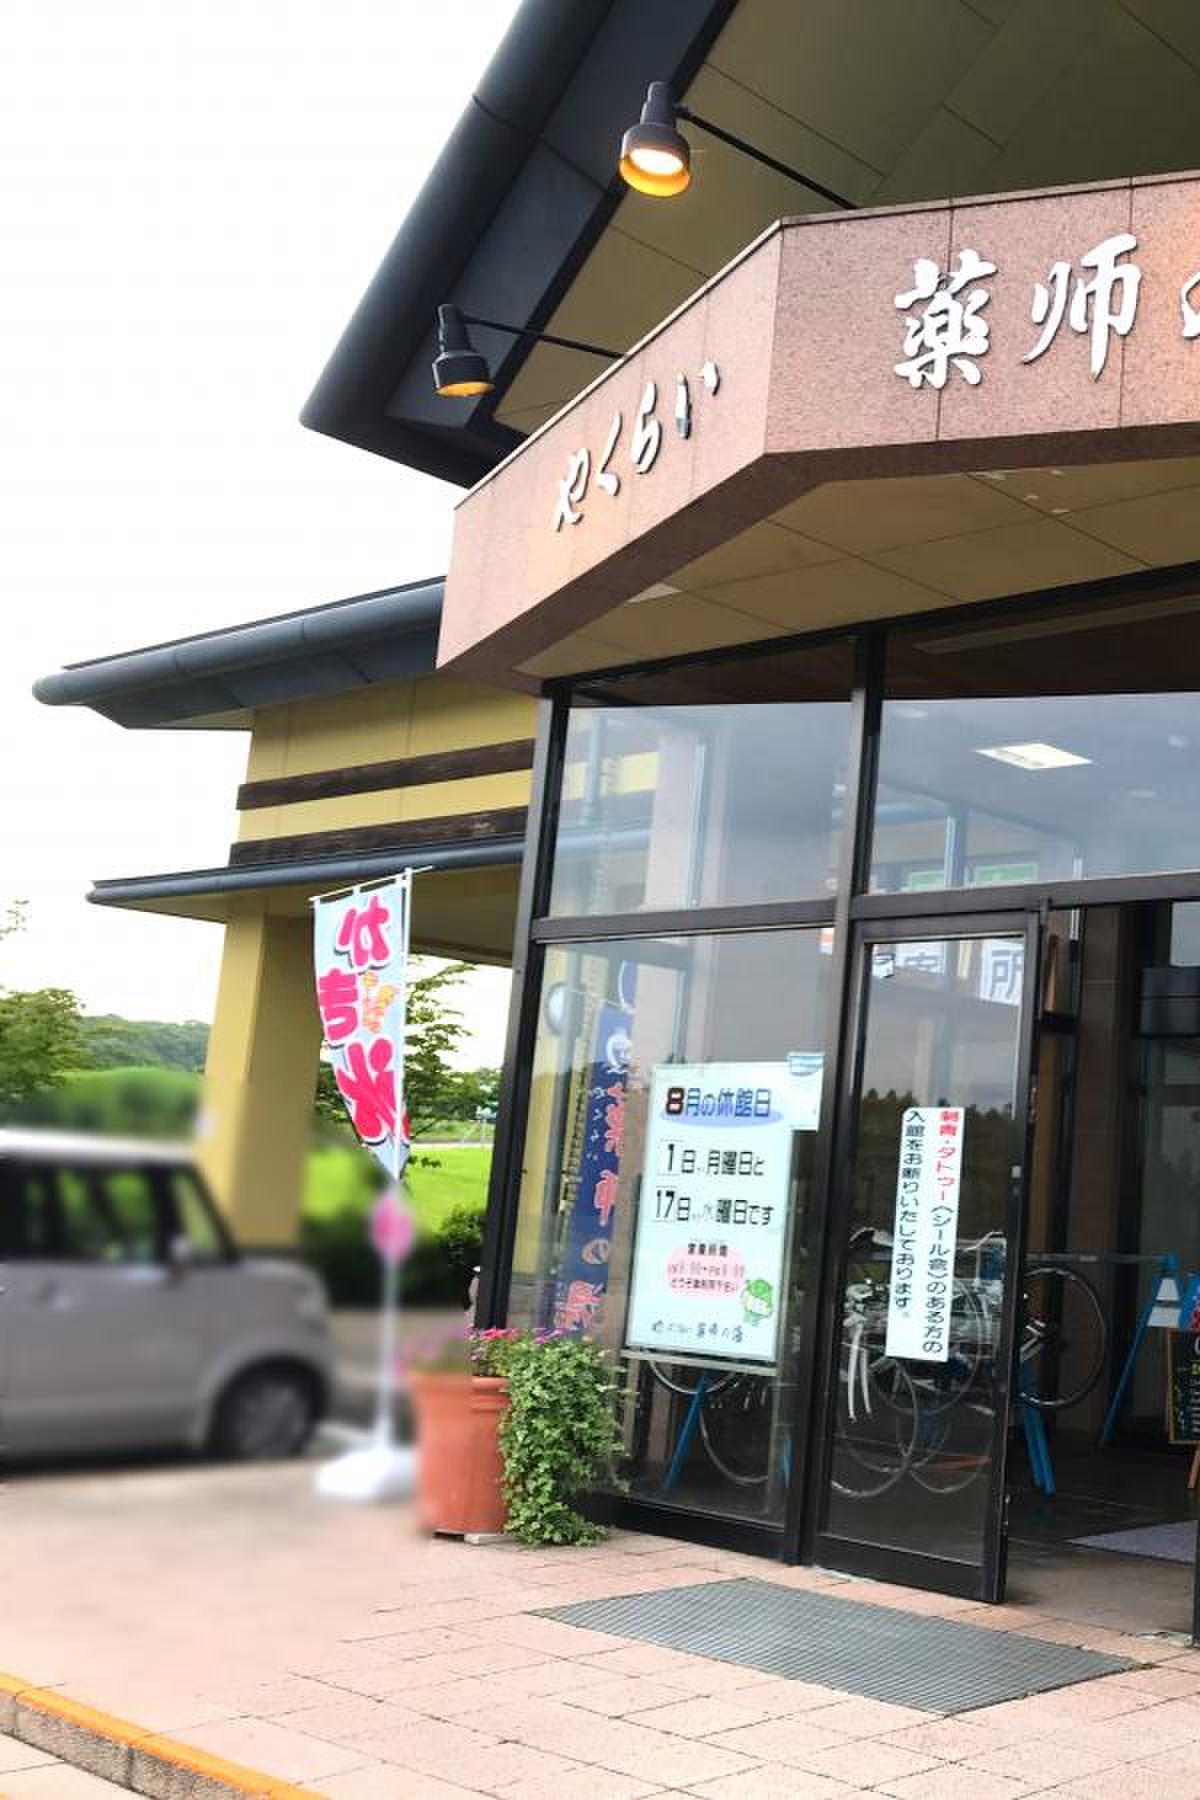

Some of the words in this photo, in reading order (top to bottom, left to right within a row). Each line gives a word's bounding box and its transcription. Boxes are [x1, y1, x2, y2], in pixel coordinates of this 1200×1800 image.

[552, 360, 721, 532] やくらい
[665, 1087, 771, 1118] 8月の休館日
